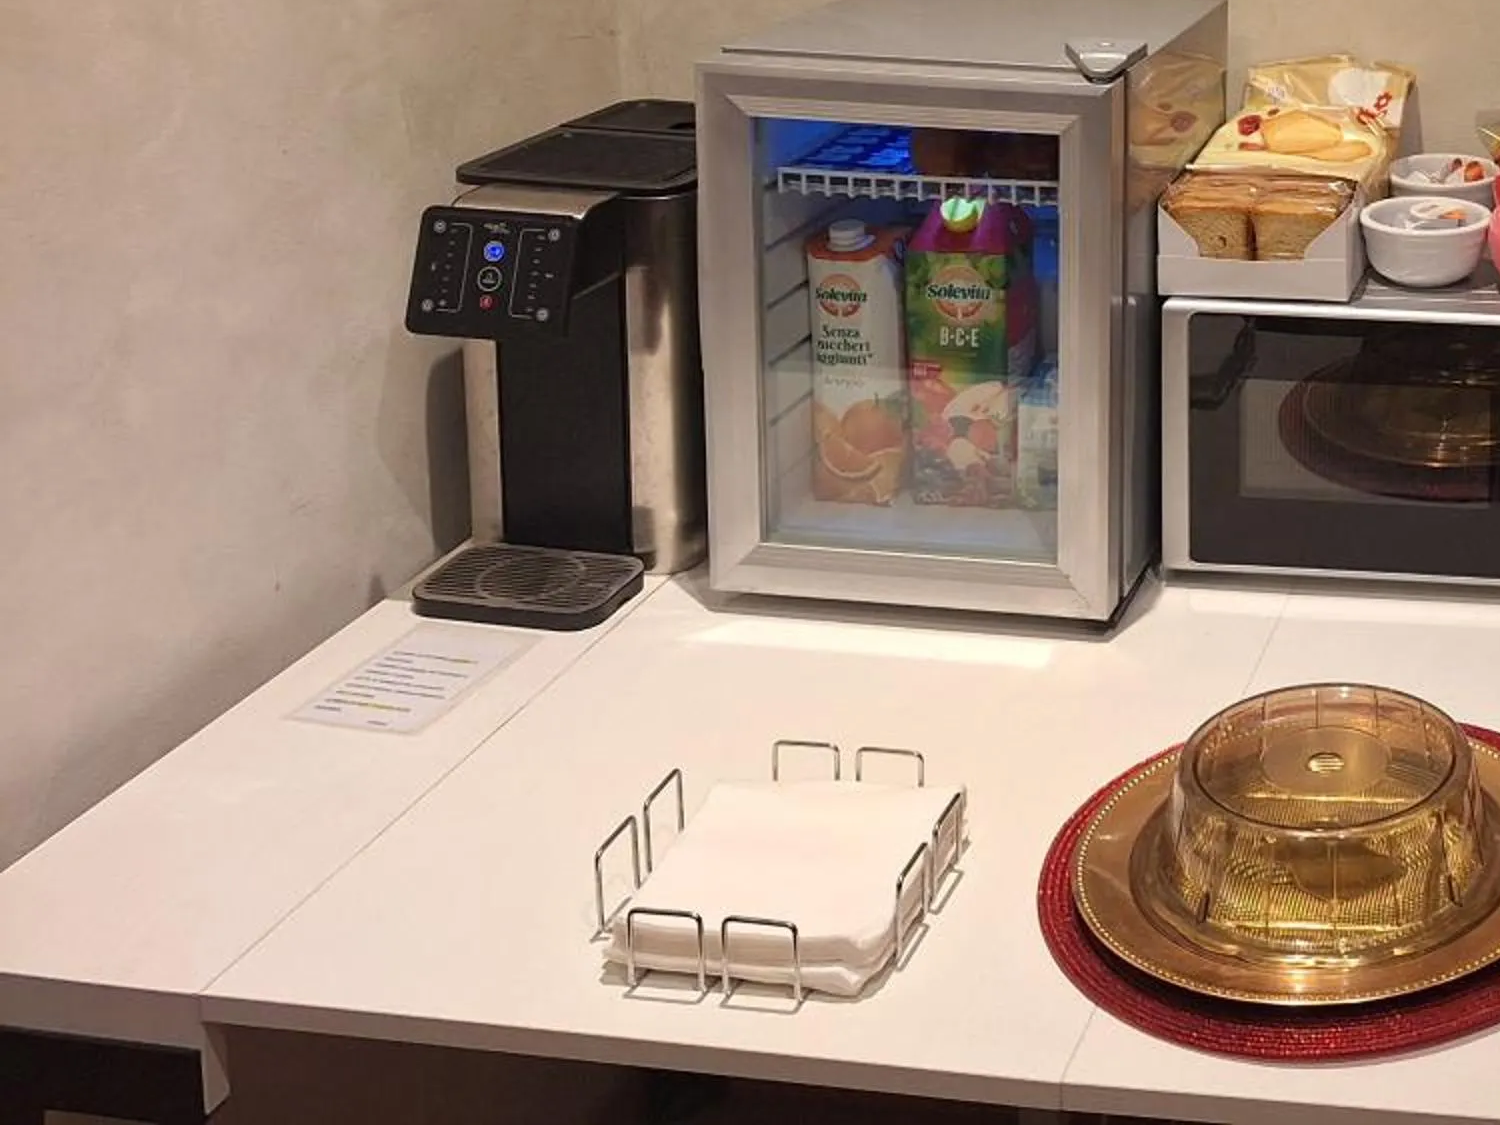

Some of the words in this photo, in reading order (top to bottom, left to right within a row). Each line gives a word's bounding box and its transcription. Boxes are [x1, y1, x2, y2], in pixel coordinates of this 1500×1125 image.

[816, 286, 867, 302] Solevita
[927, 283, 991, 300] Solevita
[822, 324, 860, 338] Senza
